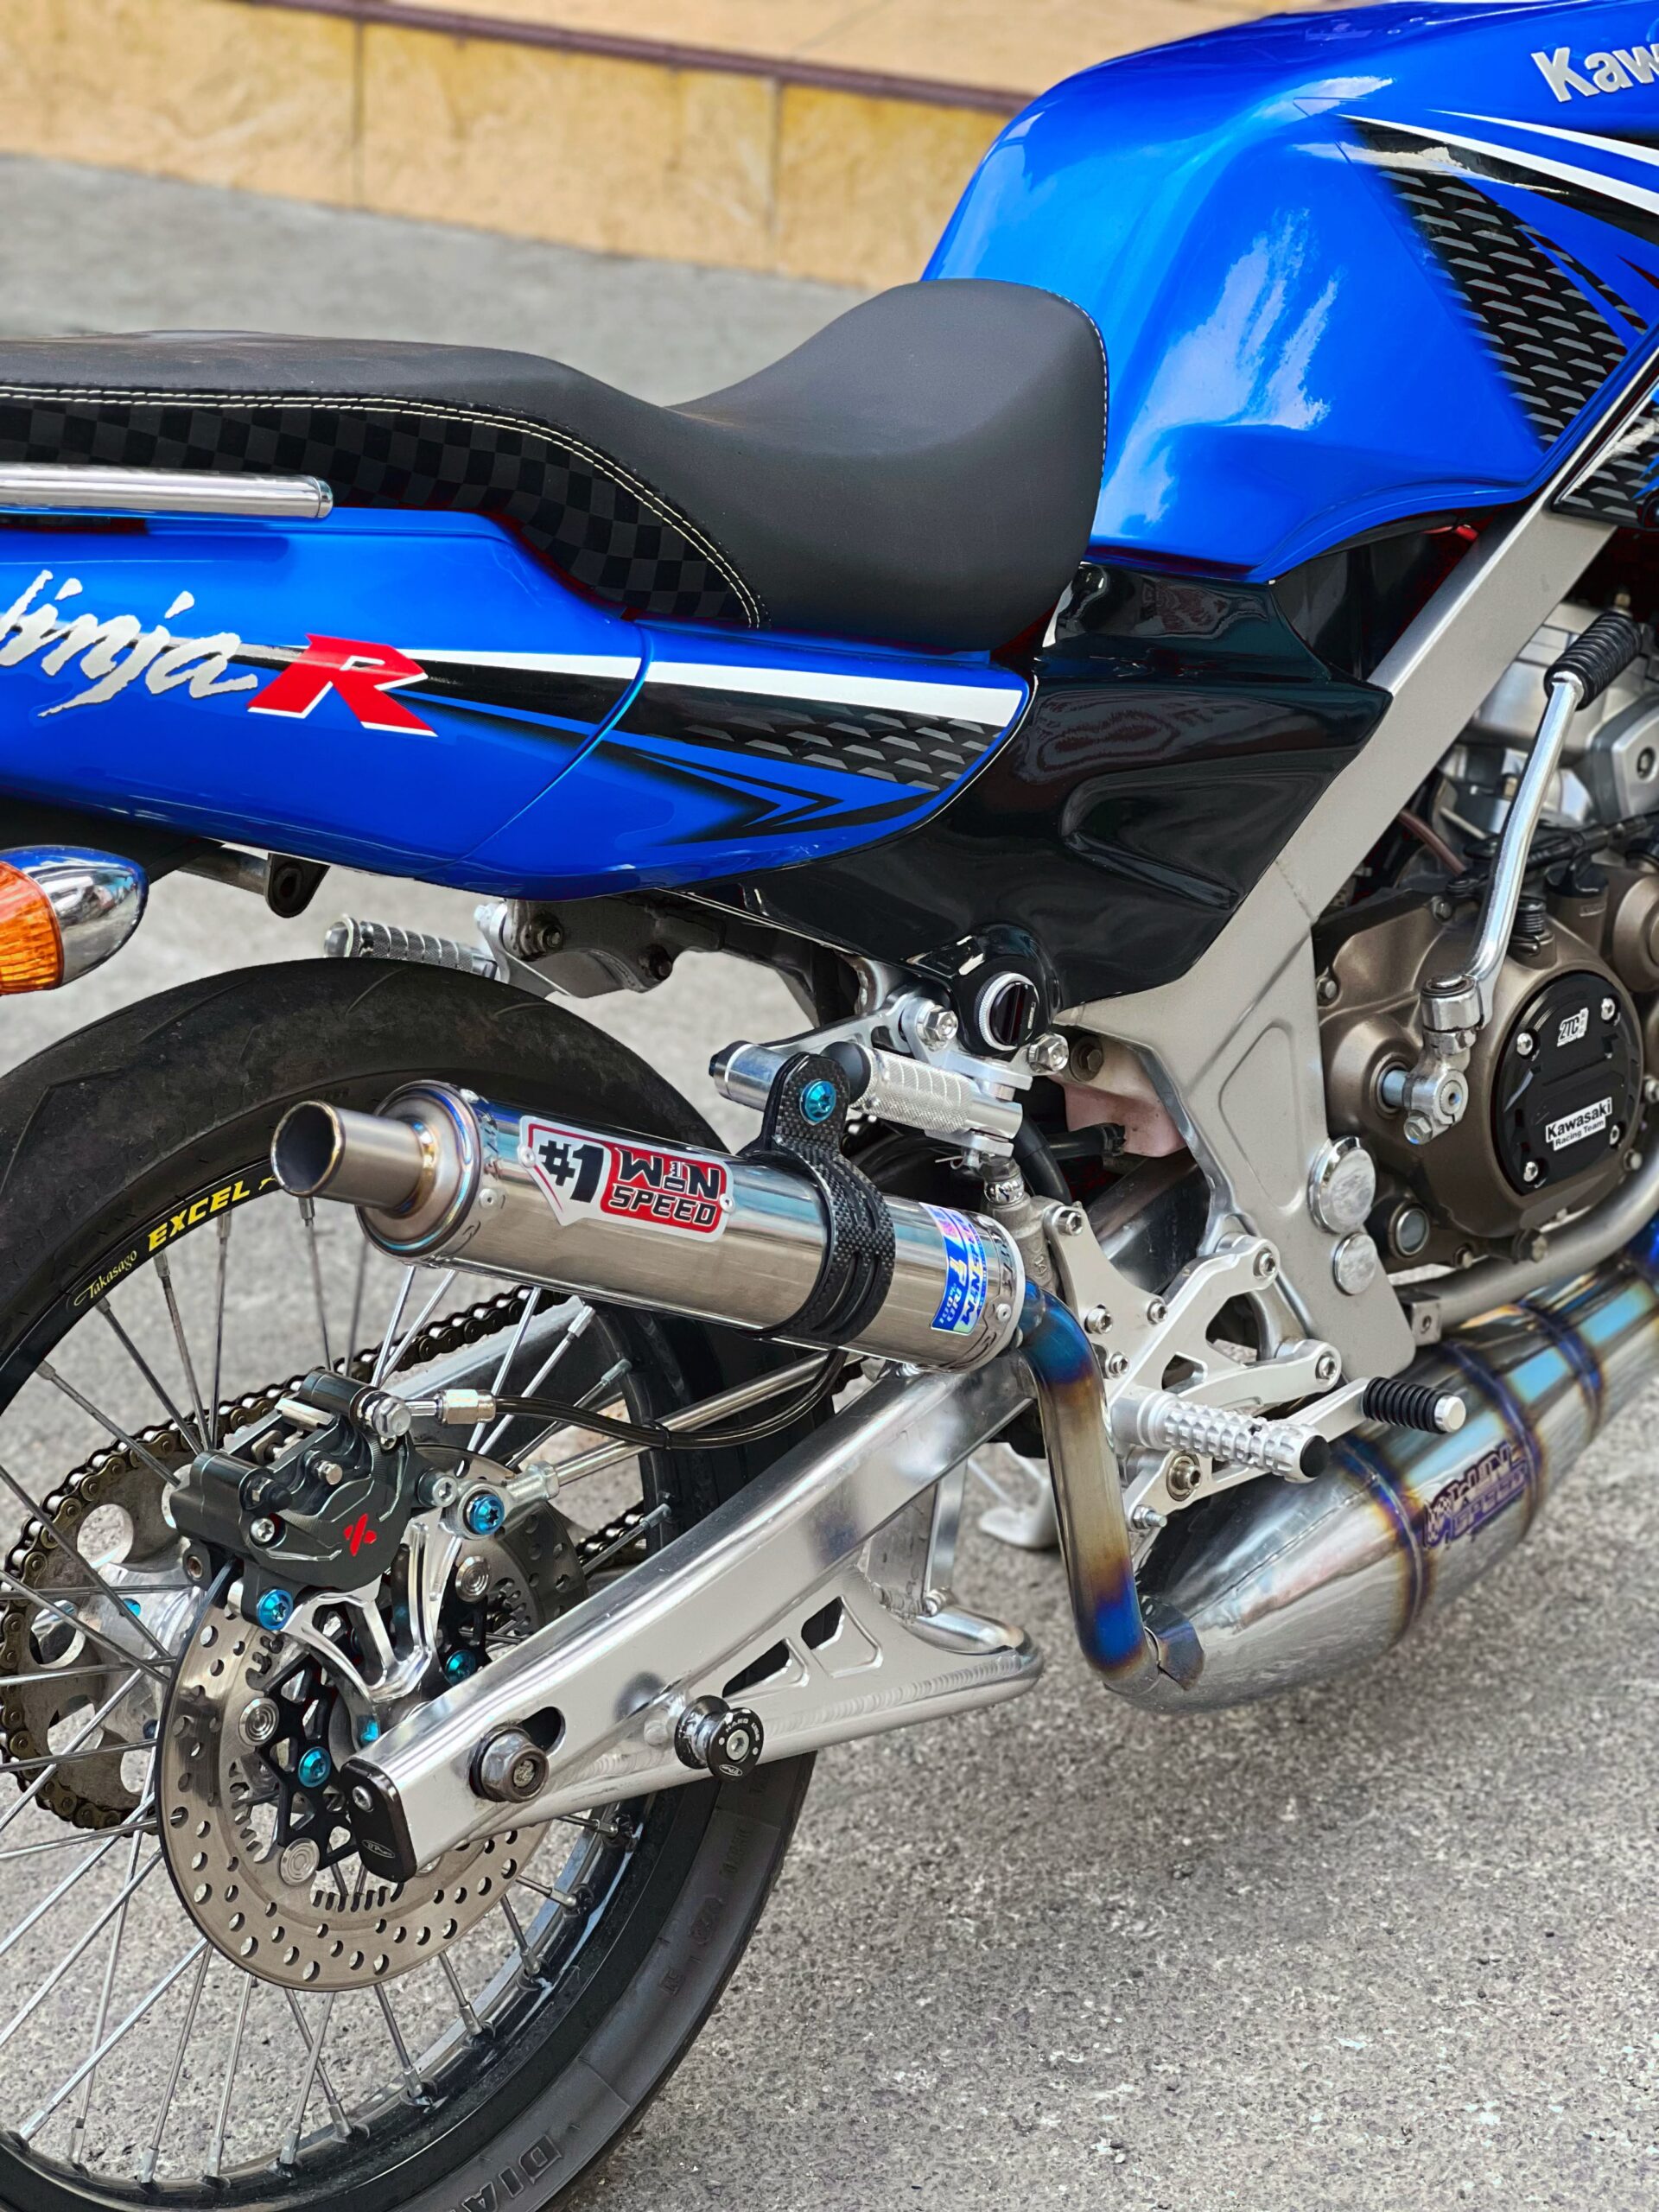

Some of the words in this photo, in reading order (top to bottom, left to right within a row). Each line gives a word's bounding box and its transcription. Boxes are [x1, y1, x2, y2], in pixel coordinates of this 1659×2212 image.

[1530, 43, 1659, 102] Kaw
[0, 569, 257, 717] inja
[247, 632, 438, 736] R
[1548, 1098, 1612, 1140] Kawasaki
[1555, 1128, 1581, 1147] Racing
[1583, 1120, 1605, 1135] Team
[538, 1140, 604, 1203] #1
[148, 1180, 251, 1252] EXCEL
[608, 1184, 717, 1226] SPEED
[74, 1250, 137, 1306] Takasago
[447, 2135, 563, 2212] DIA
